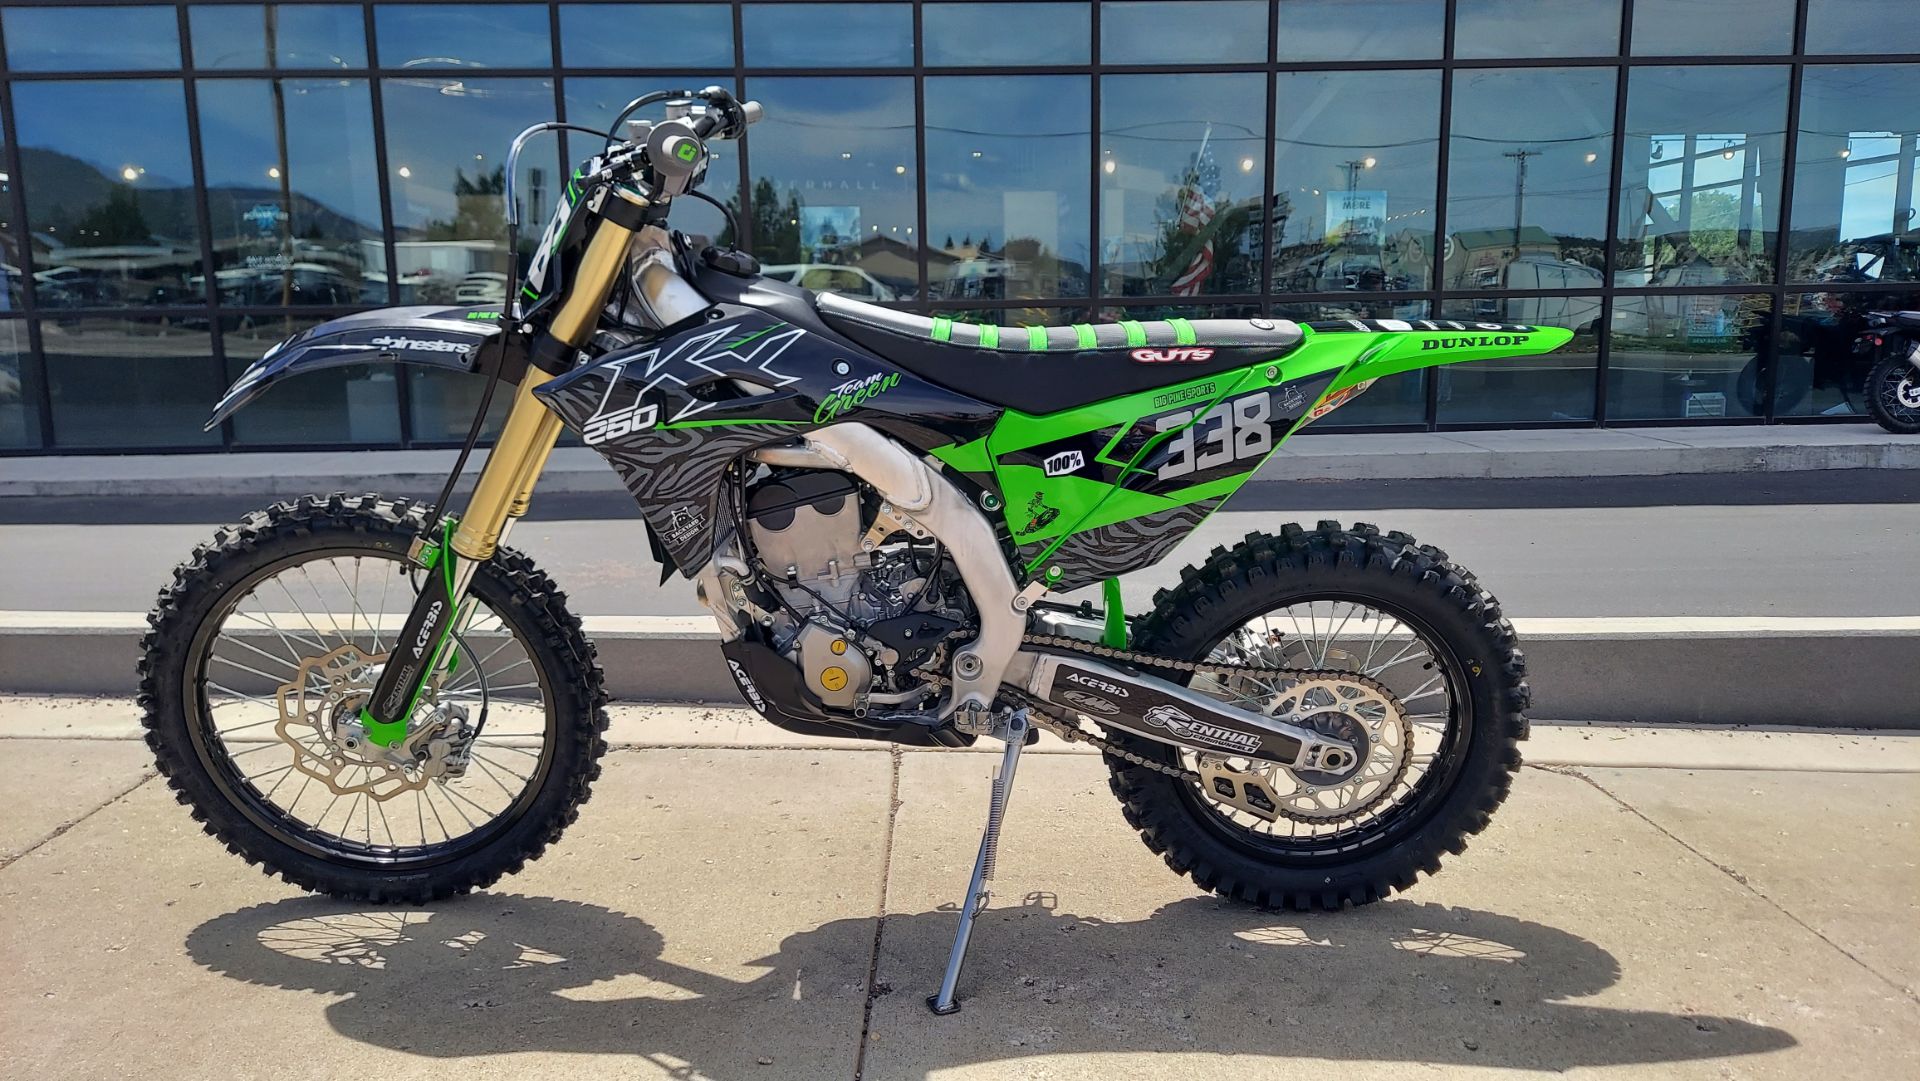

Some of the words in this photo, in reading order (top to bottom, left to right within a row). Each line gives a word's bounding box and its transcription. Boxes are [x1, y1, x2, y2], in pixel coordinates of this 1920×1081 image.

[372, 335, 471, 353] alpinestars
[1130, 347, 1216, 363] GUTS
[1421, 335, 1530, 351] DUNLOP
[813, 372, 902, 424] Green
[830, 372, 884, 398] Team
[1153, 396, 1168, 409] BIG
[1185, 382, 1216, 400] SPORTS
[582, 403, 659, 445] 250
[1155, 391, 1272, 481] 338
[1046, 451, 1081, 474] 100%
[671, 518, 699, 539] BACKYARD
[679, 527, 700, 542] DESIGN
[412, 600, 443, 659] ACERBIS
[727, 659, 766, 713] ACERBIS
[1066, 672, 1130, 698] ACERBIS
[1143, 704, 1261, 748] RENTHAL
